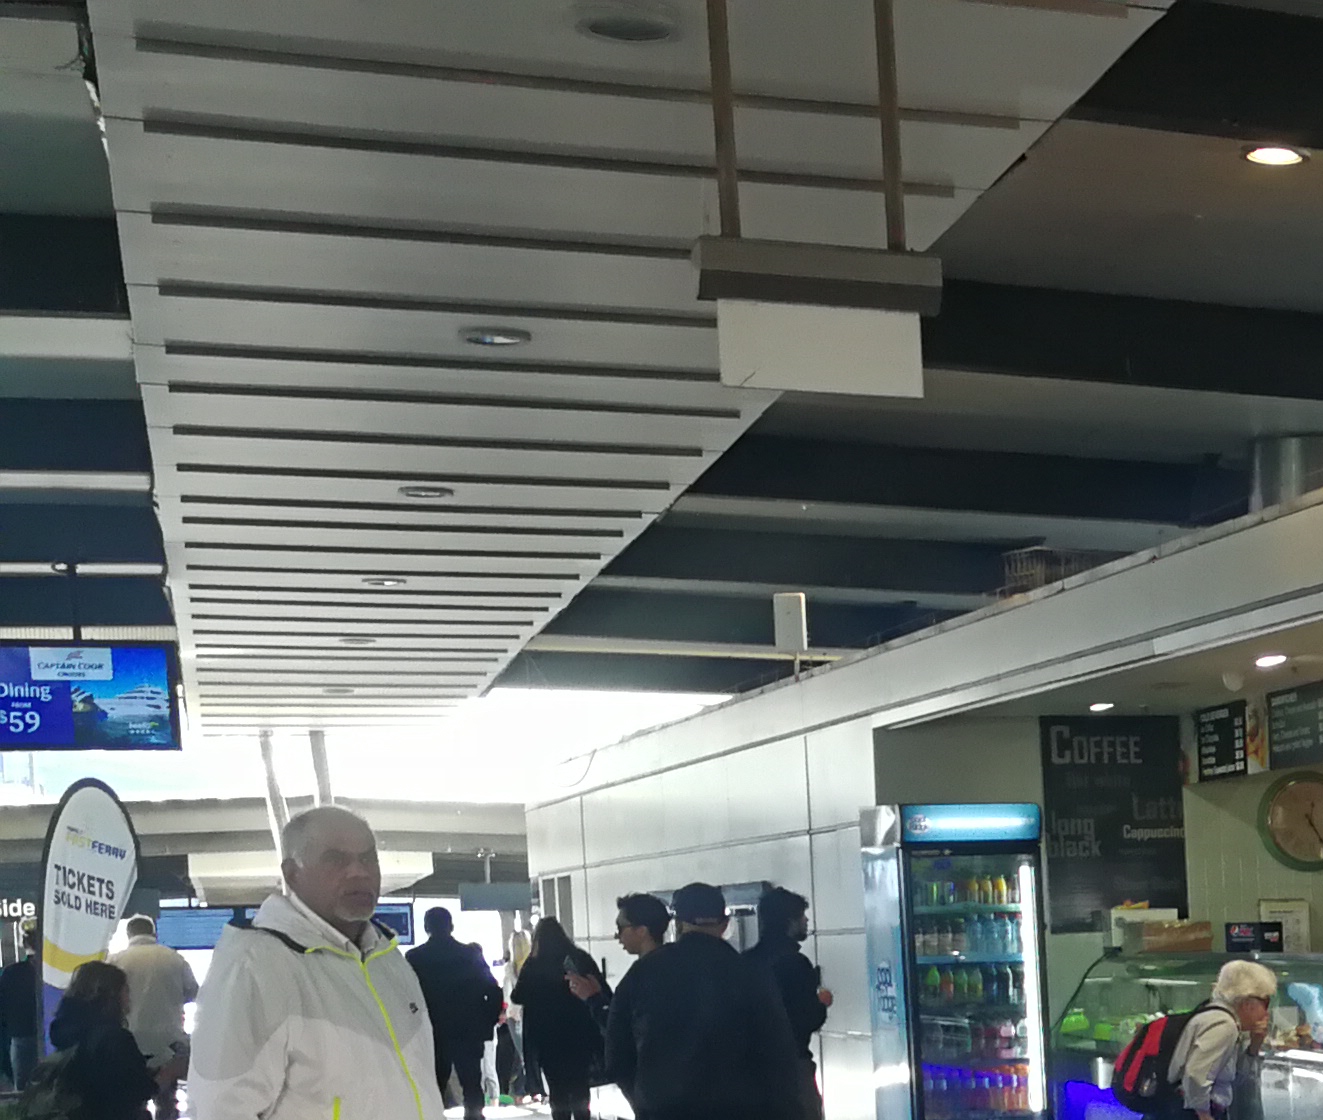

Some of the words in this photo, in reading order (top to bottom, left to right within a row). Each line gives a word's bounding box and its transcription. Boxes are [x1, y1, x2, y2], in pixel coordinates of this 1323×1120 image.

[37, 662, 77, 671] CAPTAIN
[77, 662, 104, 671] COOK
[1050, 725, 1144, 765] COFFEE
[1132, 791, 1183, 822] Latt
[1051, 808, 1095, 842] long
[54, 863, 115, 901] TICKETS
[53, 889, 82, 911] SOLD
[85, 900, 116, 920] HERE
